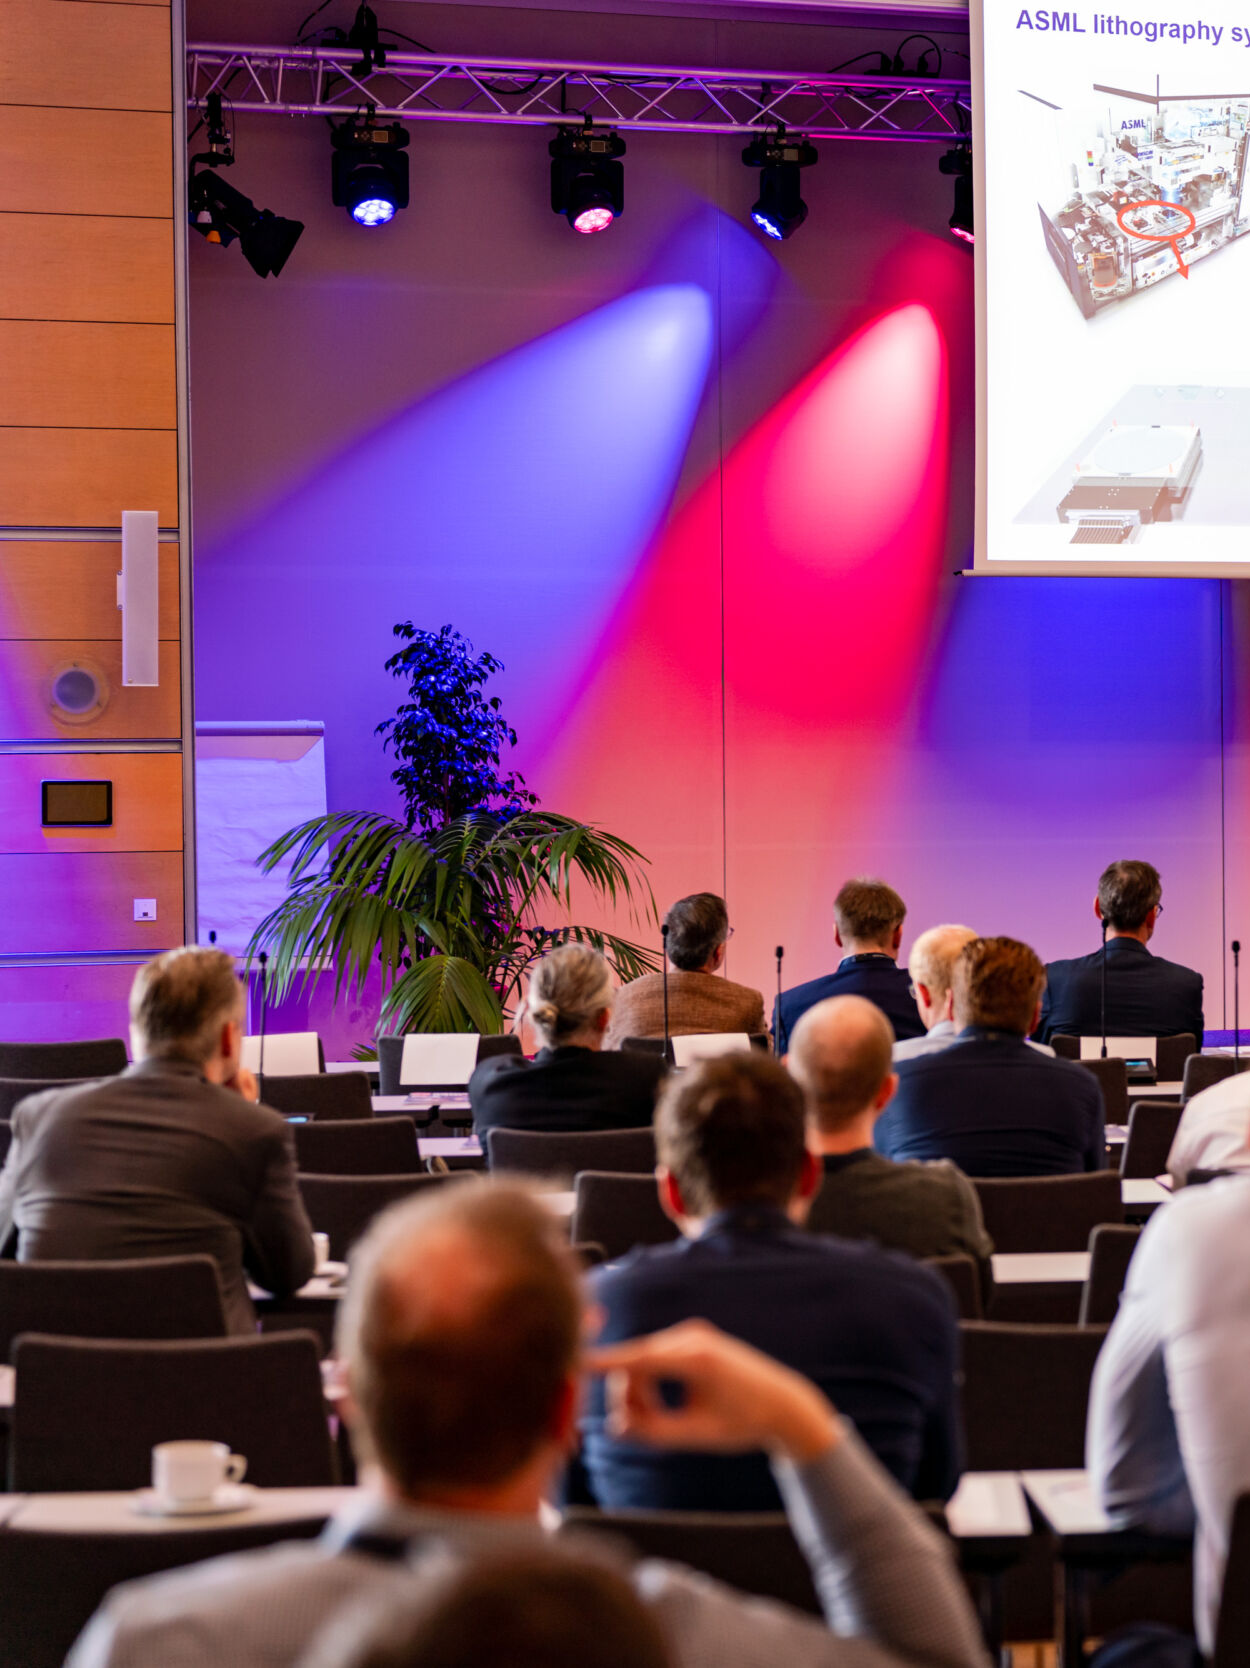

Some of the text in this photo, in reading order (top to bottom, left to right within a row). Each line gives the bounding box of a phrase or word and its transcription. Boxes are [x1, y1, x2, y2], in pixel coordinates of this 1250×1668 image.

[1015, 9, 1087, 33] ASML
[1093, 13, 1225, 47] lithography
[1121, 119, 1147, 130] ASML
